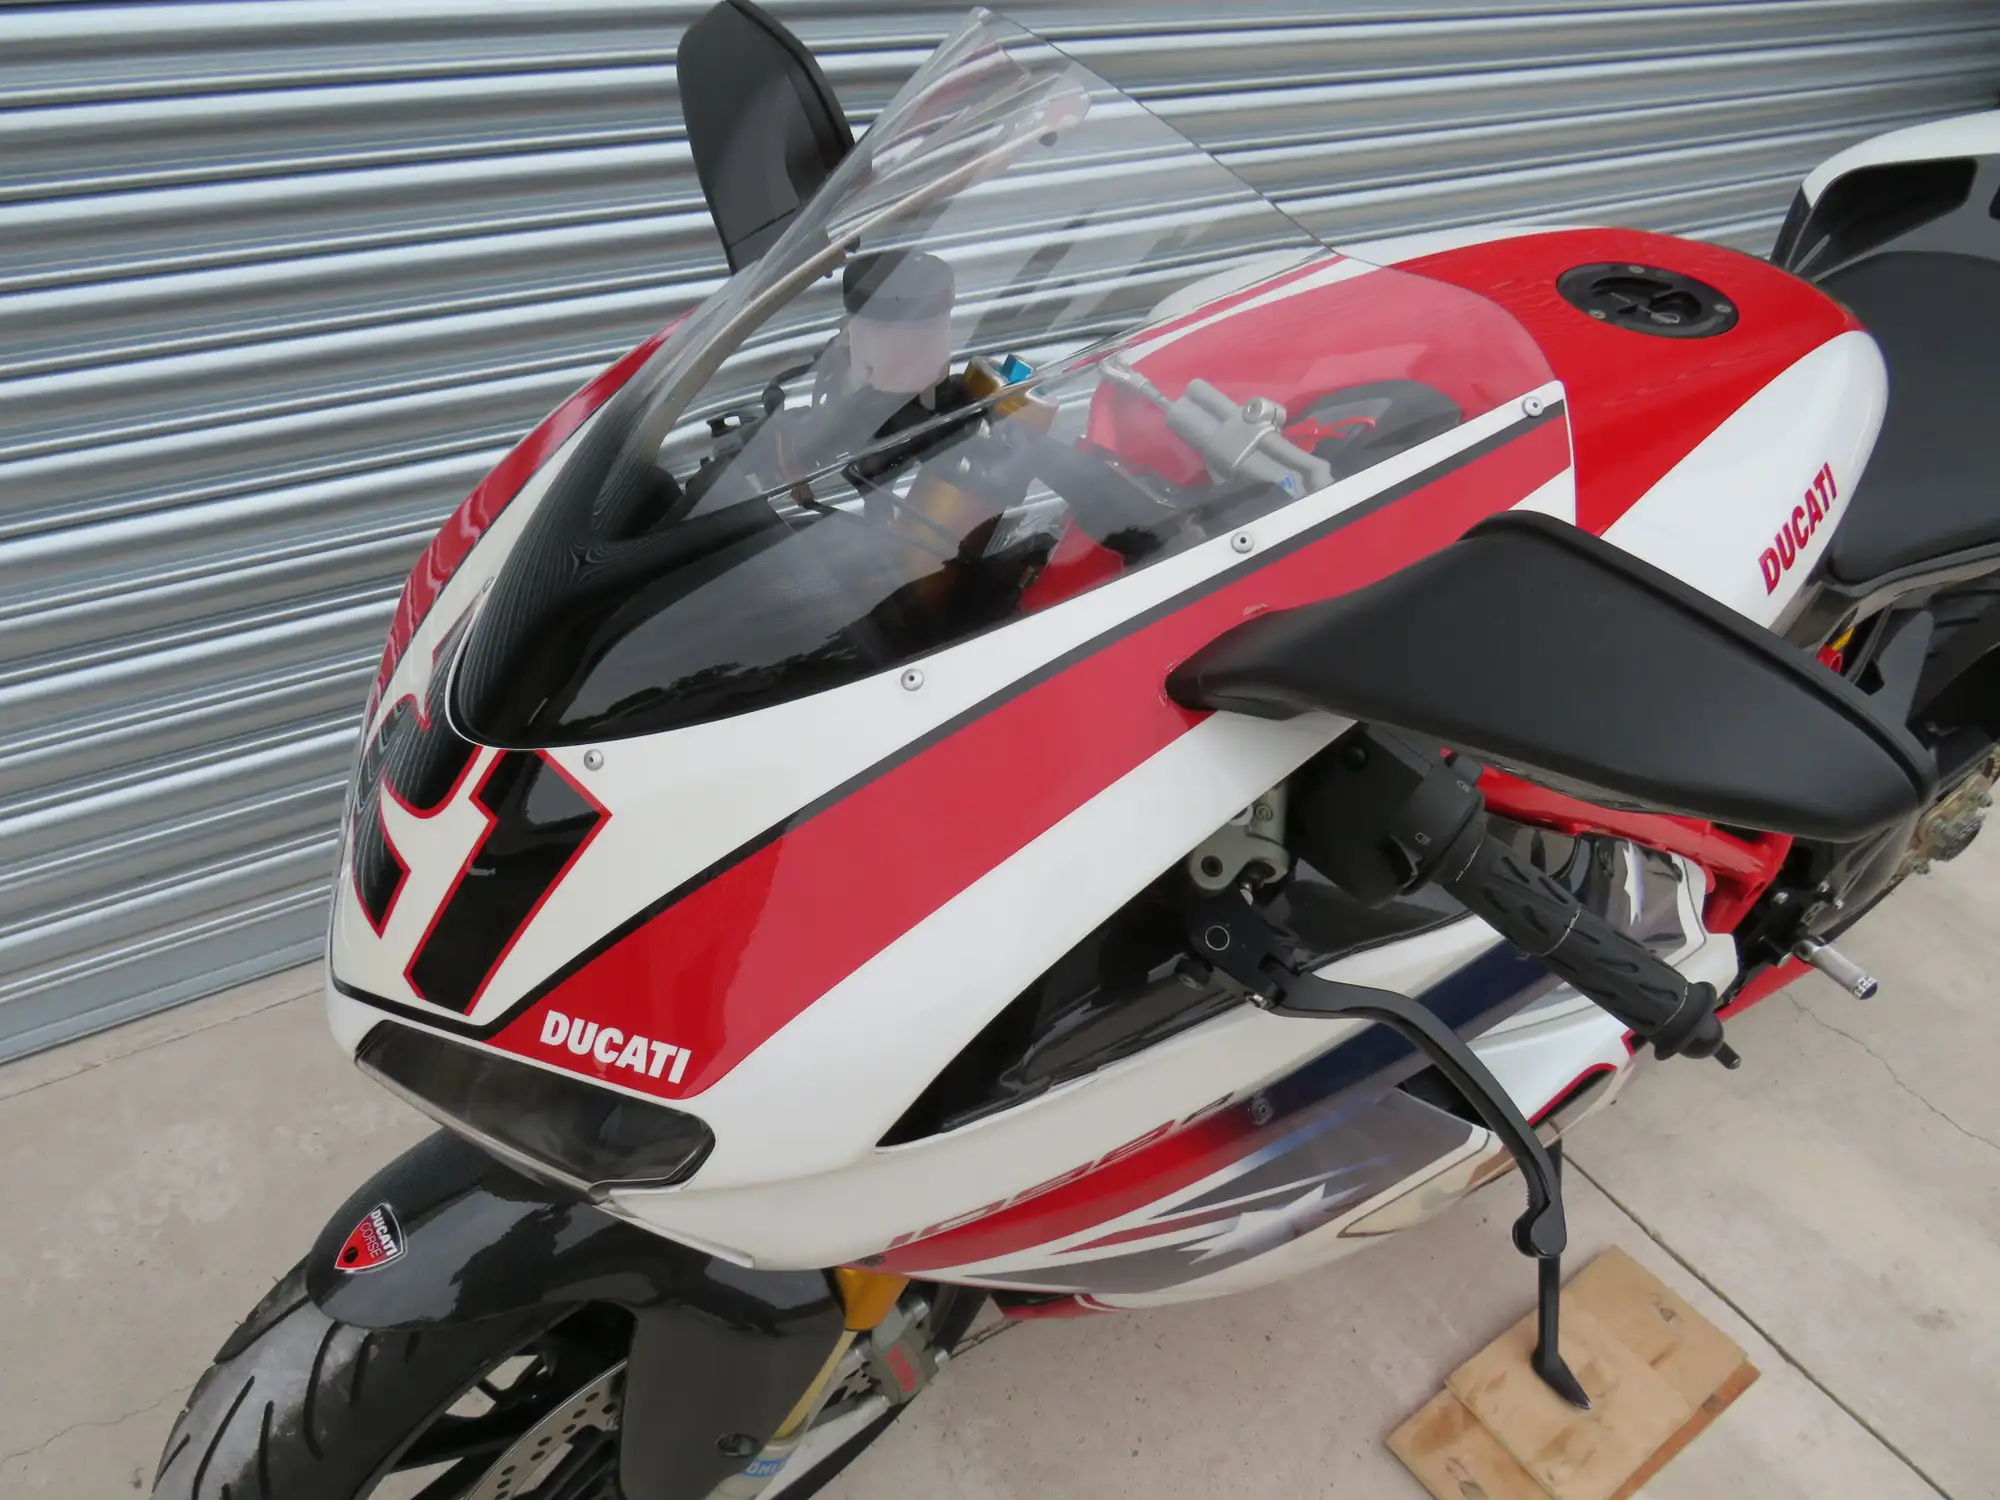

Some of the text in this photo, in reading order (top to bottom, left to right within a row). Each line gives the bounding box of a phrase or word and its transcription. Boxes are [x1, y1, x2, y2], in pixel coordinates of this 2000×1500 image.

[1758, 461, 1837, 596] DUCATI
[540, 1010, 692, 1084] DUCATI
[359, 1222, 382, 1259] CORSE
[370, 1208, 399, 1257] DUCATI
